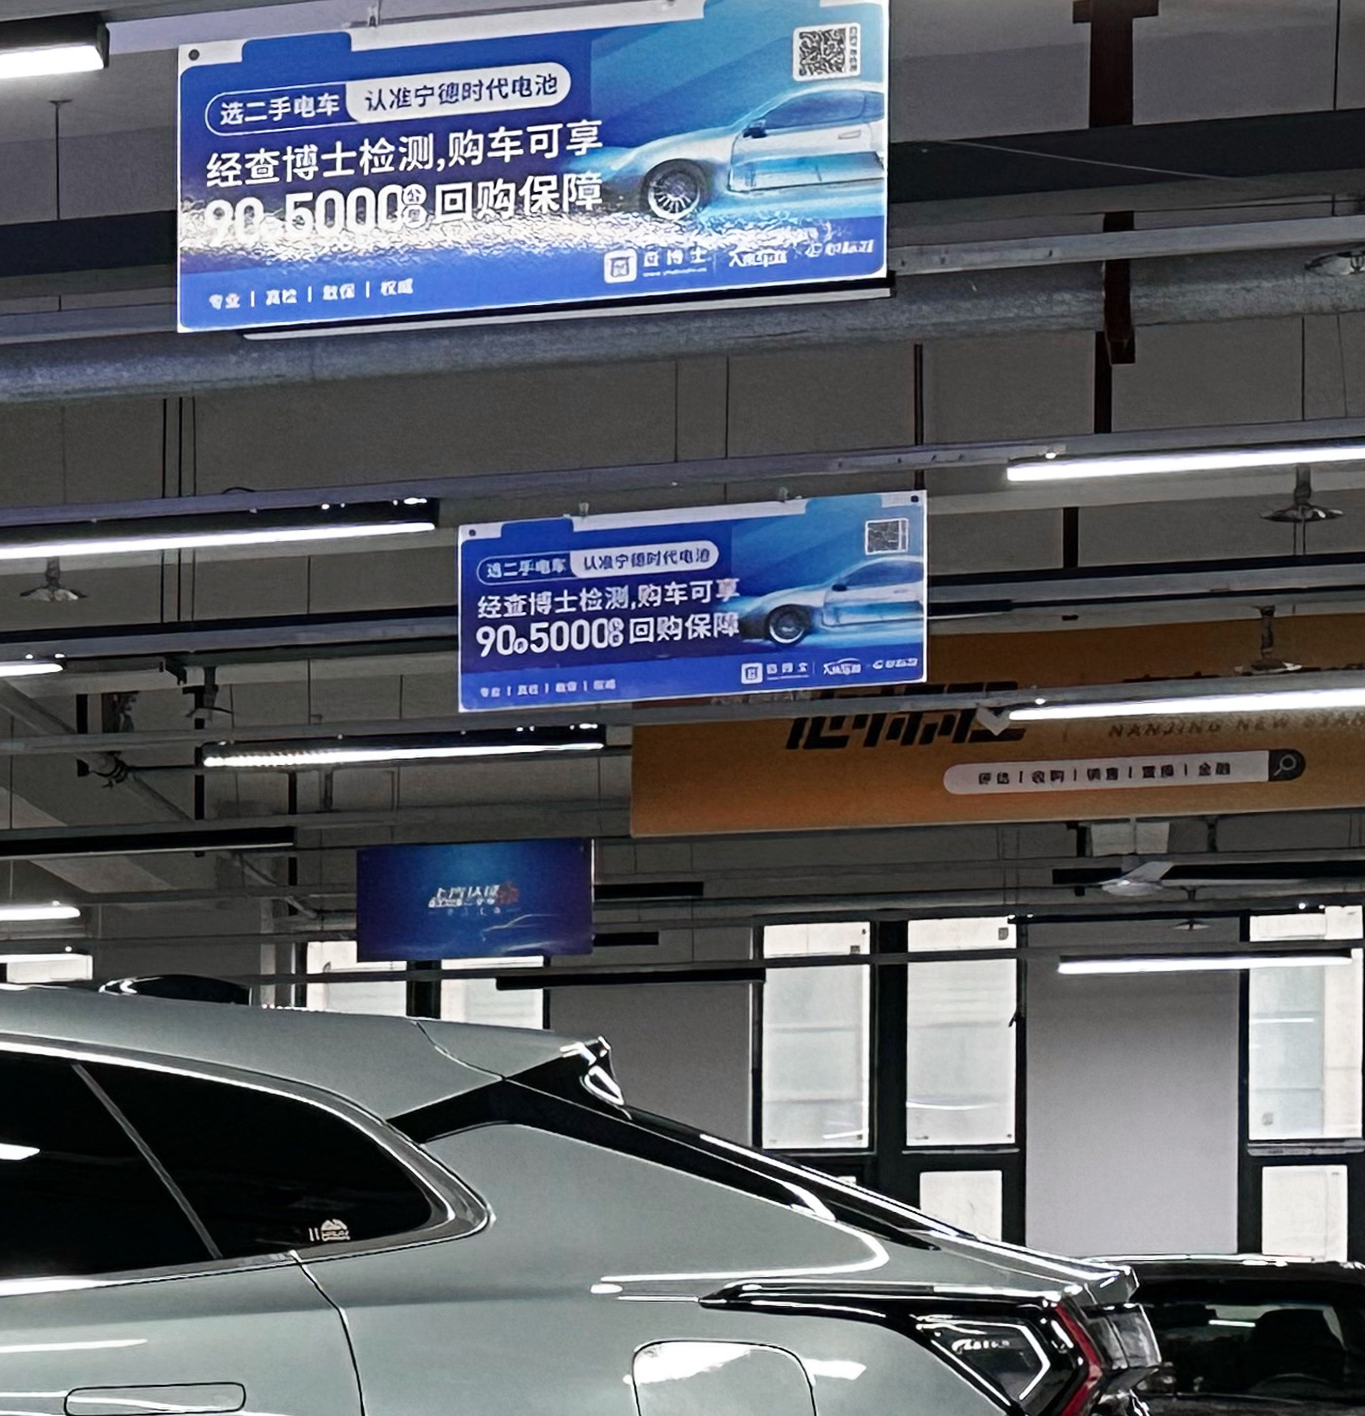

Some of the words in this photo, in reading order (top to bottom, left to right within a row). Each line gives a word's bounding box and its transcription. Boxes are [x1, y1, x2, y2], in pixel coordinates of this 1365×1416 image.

[218, 92, 341, 127] 选二手电车
[363, 72, 559, 113] 认准宁德时代电池
